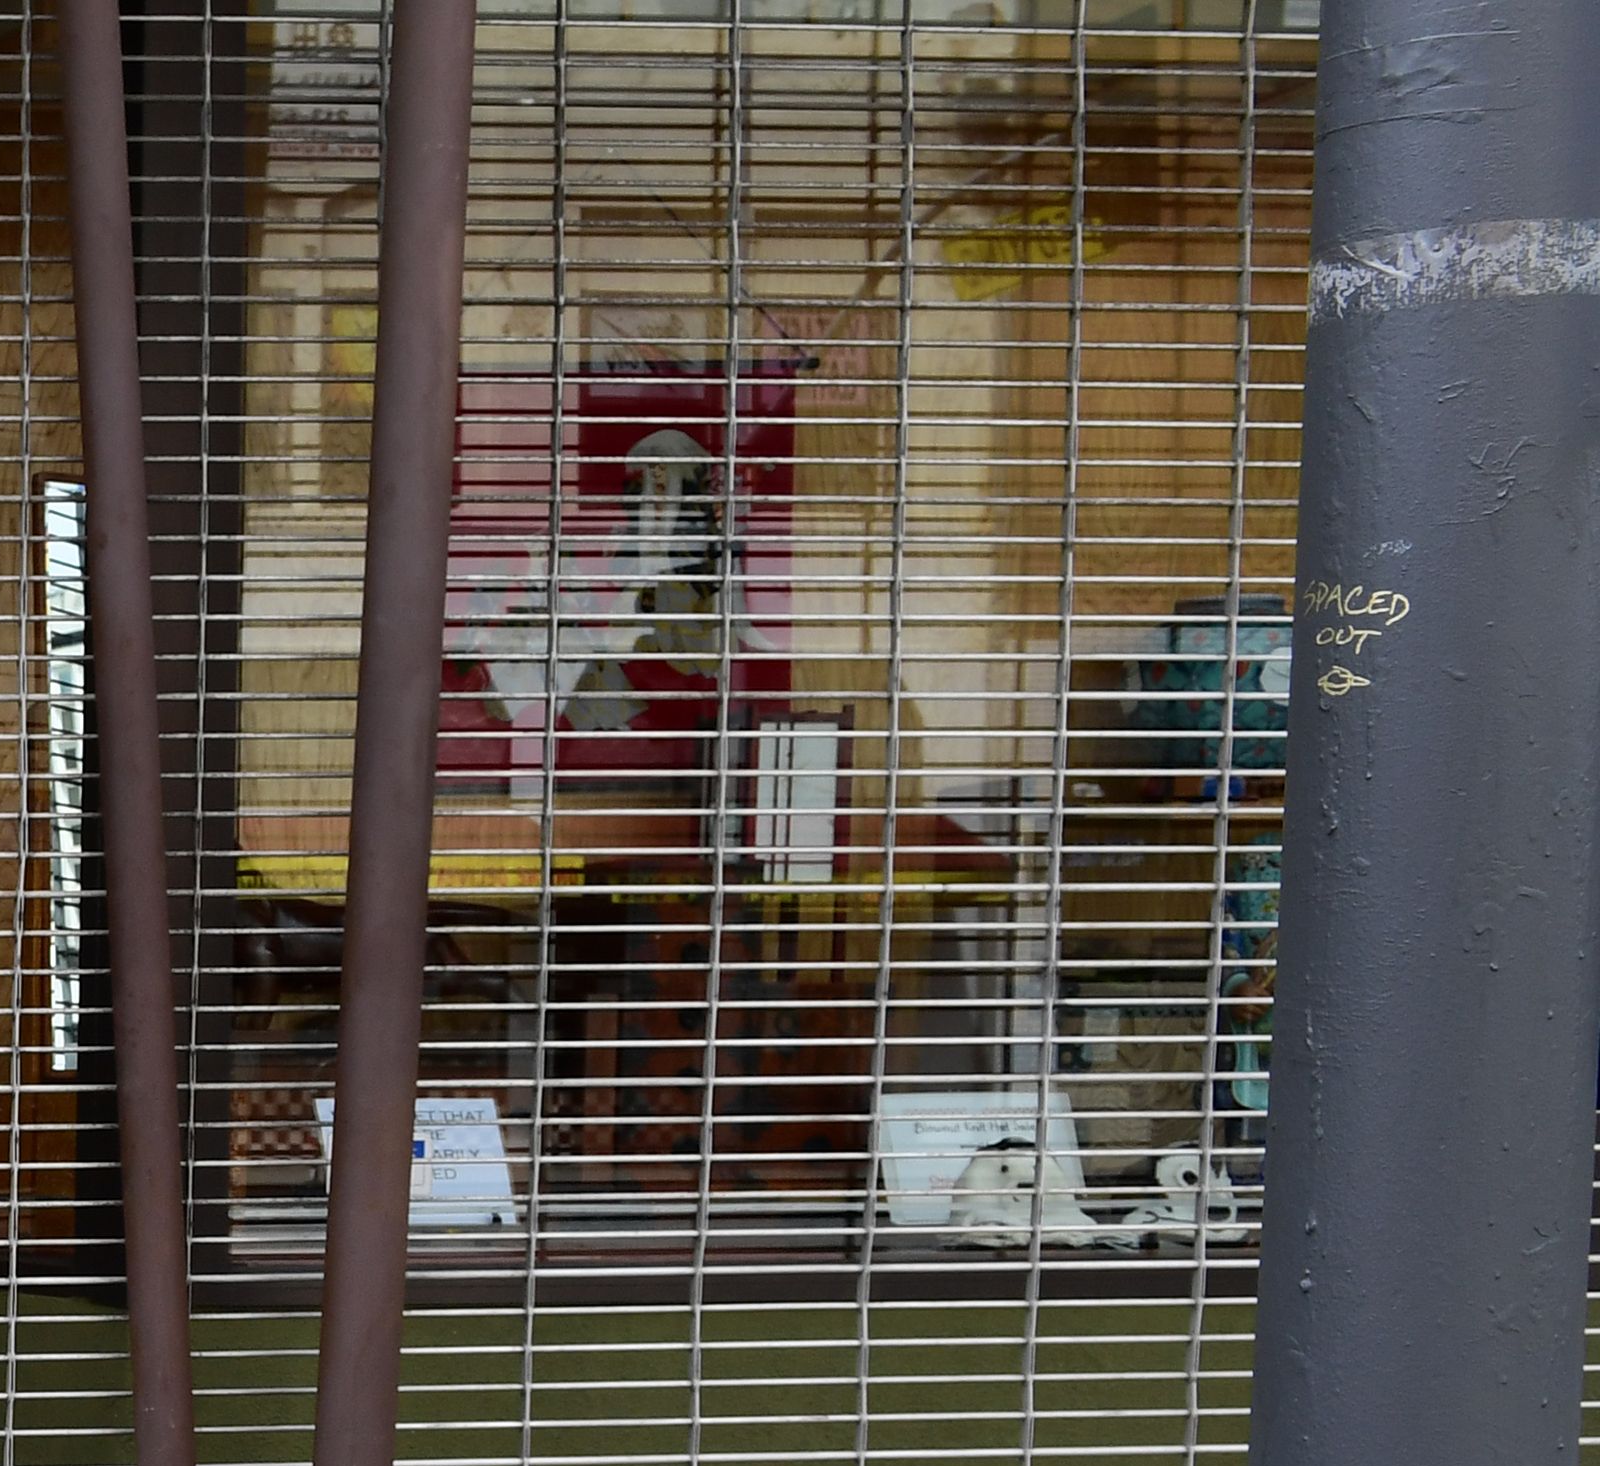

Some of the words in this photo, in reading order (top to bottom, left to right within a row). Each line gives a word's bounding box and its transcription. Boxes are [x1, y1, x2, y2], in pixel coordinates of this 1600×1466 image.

[1304, 580, 1410, 626] SPACED
[1316, 625, 1382, 655] OUT
[438, 1110, 485, 1121] THAT
